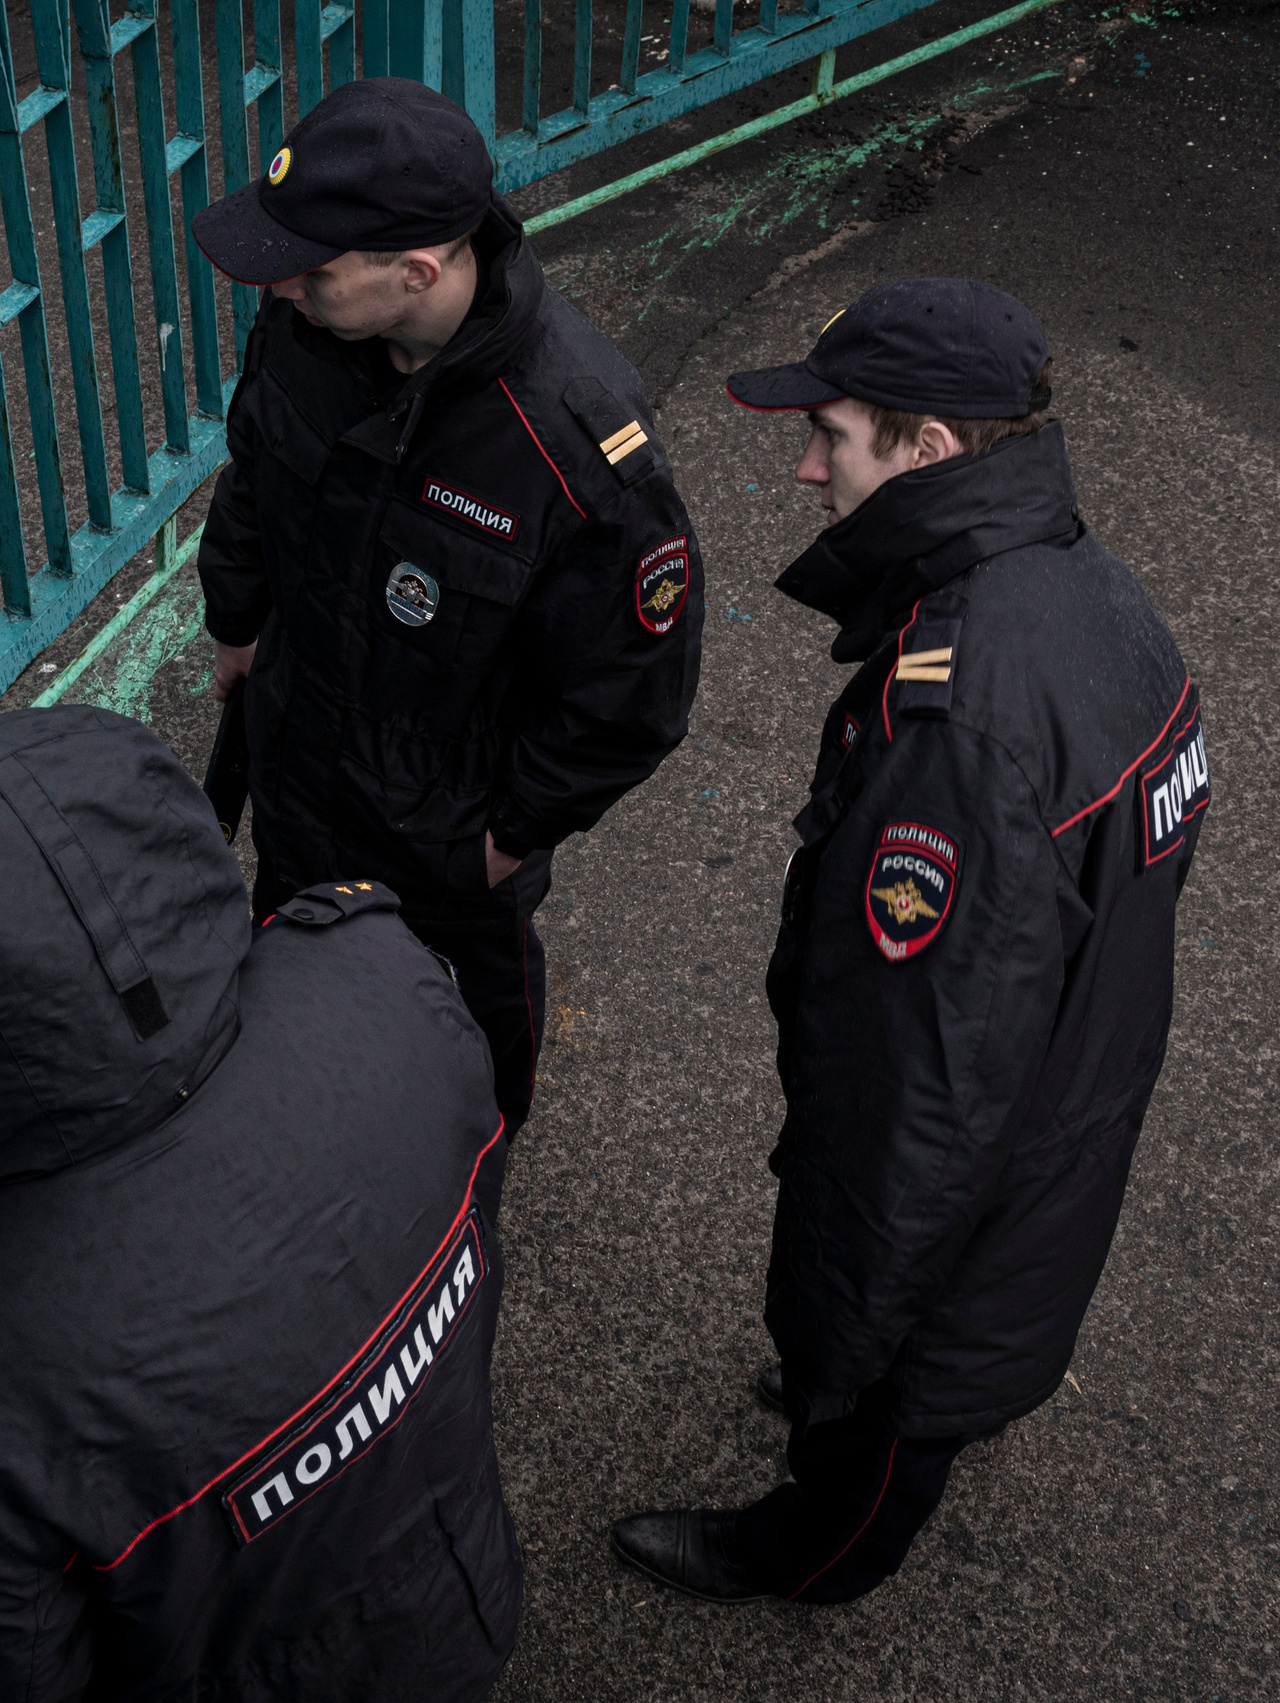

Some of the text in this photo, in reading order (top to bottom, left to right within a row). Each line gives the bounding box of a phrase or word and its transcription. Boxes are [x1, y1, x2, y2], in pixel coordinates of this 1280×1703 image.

[428, 484, 513, 534] ПОЛИЦИЯ
[641, 539, 684, 569] ПОЛИЦИЯ
[643, 558, 684, 590] РОССИЯ
[655, 616, 674, 632] МВД
[887, 826, 954, 862] ПОЛИЦИЯ
[882, 855, 945, 893] РОССИЯ
[880, 932, 908, 959] МВД
[251, 1244, 475, 1522] ПОЛИЦИЯ
